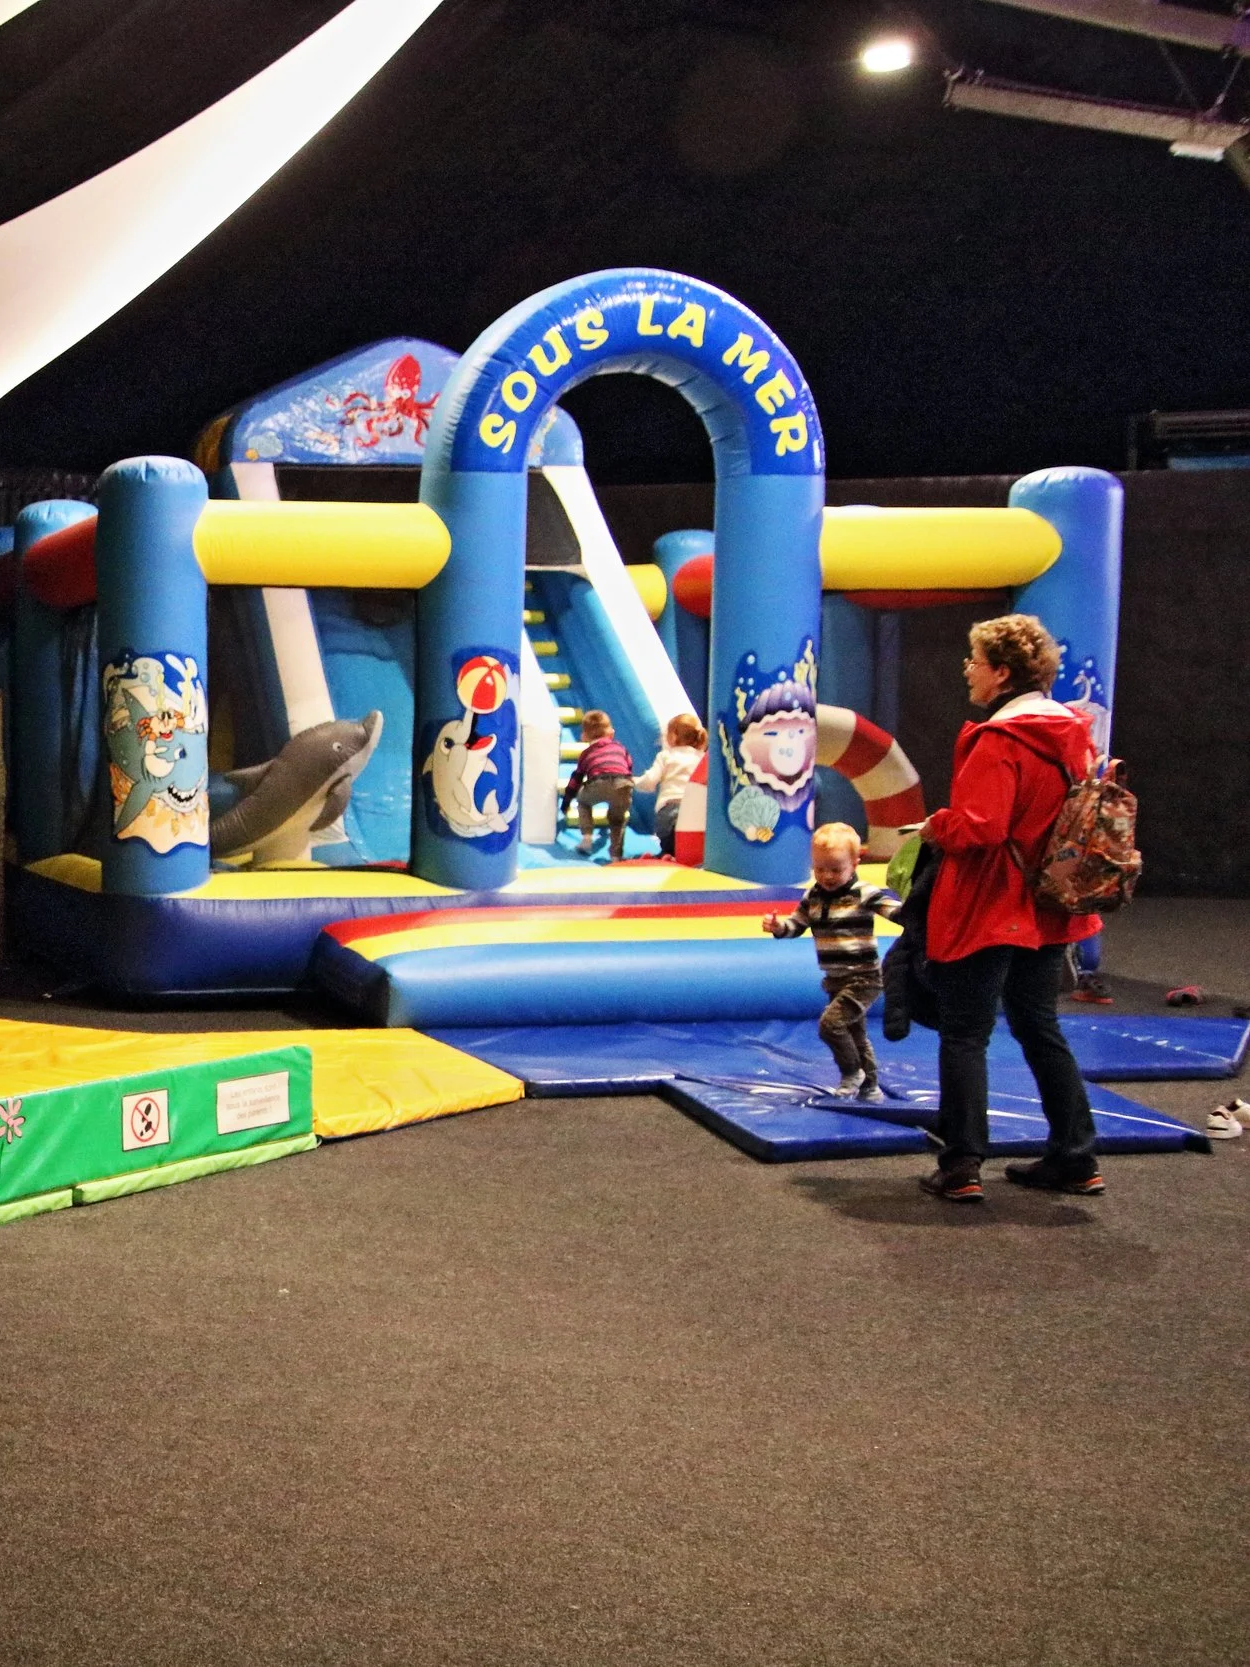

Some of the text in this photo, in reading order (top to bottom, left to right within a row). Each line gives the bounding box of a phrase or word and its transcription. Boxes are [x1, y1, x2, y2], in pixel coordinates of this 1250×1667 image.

[479, 296, 808, 457] SOUS LA MER
